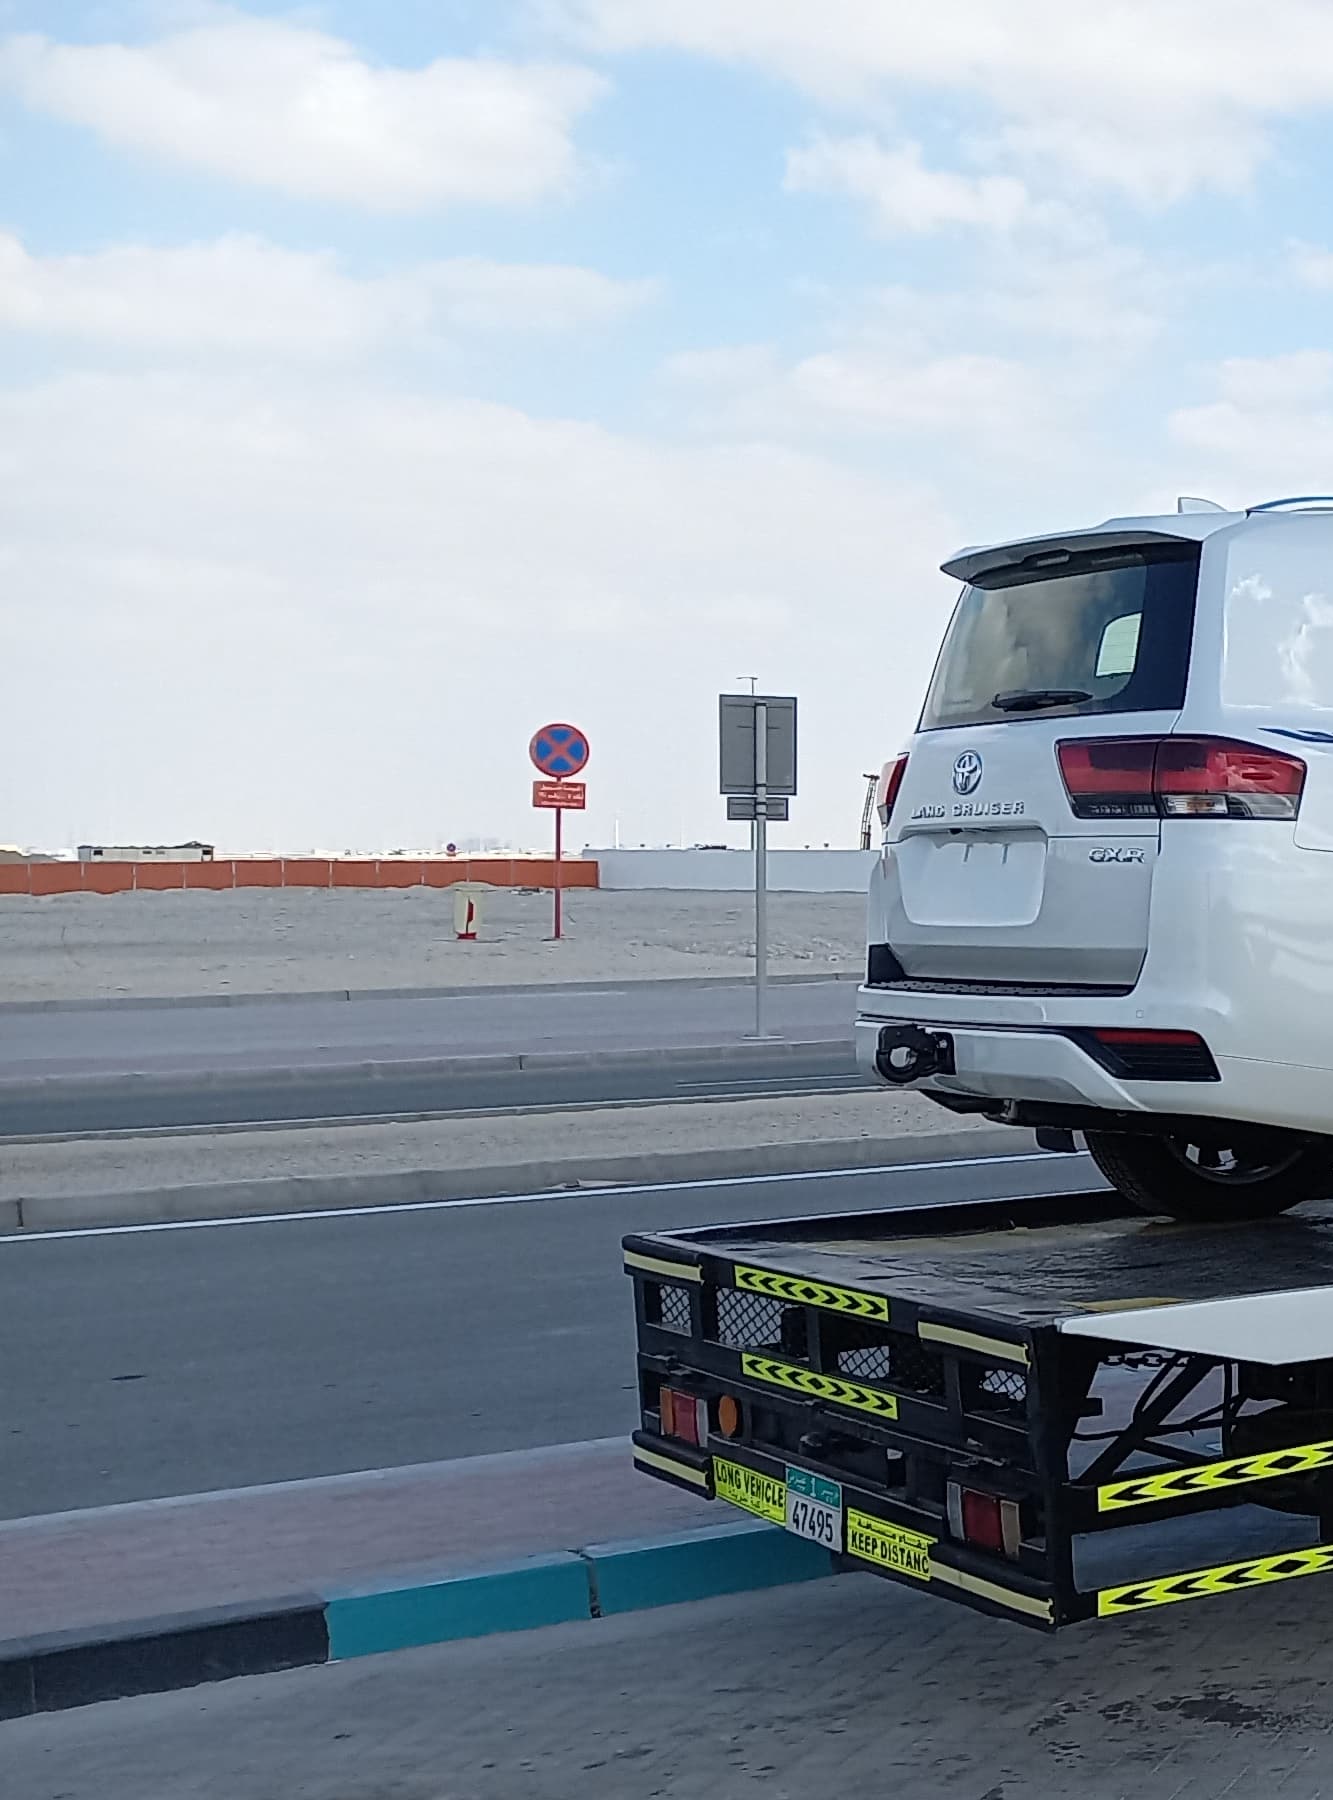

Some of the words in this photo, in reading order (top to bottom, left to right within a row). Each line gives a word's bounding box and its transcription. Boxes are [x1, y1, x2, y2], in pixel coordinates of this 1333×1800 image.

[911, 804, 945, 819] LAND
[951, 801, 1025, 817] CRUISER
[716, 1461, 741, 1489] LONG
[744, 1470, 785, 1508] VEHICLE
[793, 1500, 834, 1542] 47495
[851, 1530, 878, 1555] KEEP
[881, 1541, 929, 1574] DISTANC
